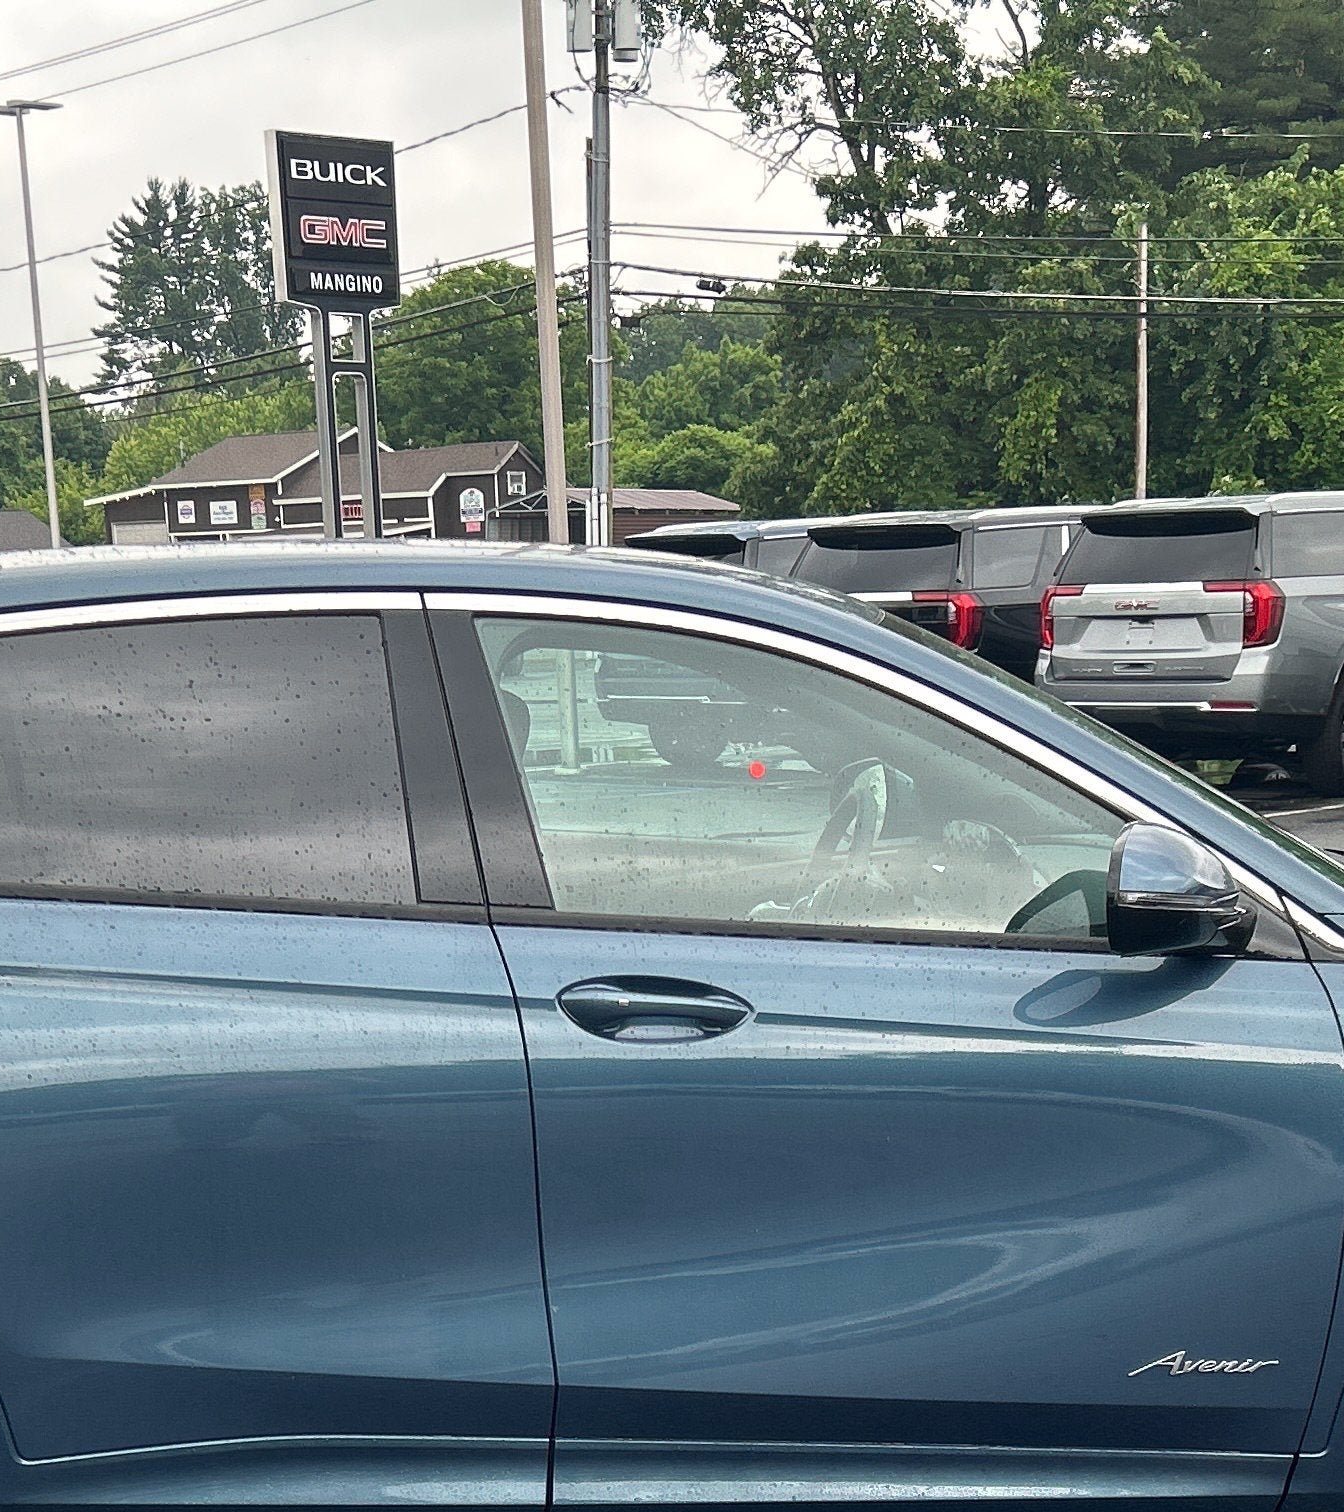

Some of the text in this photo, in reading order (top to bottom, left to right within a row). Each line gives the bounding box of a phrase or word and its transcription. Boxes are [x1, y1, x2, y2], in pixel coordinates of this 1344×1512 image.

[290, 158, 387, 187] BUICK
[300, 214, 387, 249] GMC
[310, 272, 383, 294] MANGINO
[1114, 600, 1160, 611] GMC
[1127, 1350, 1280, 1377] Avenir
